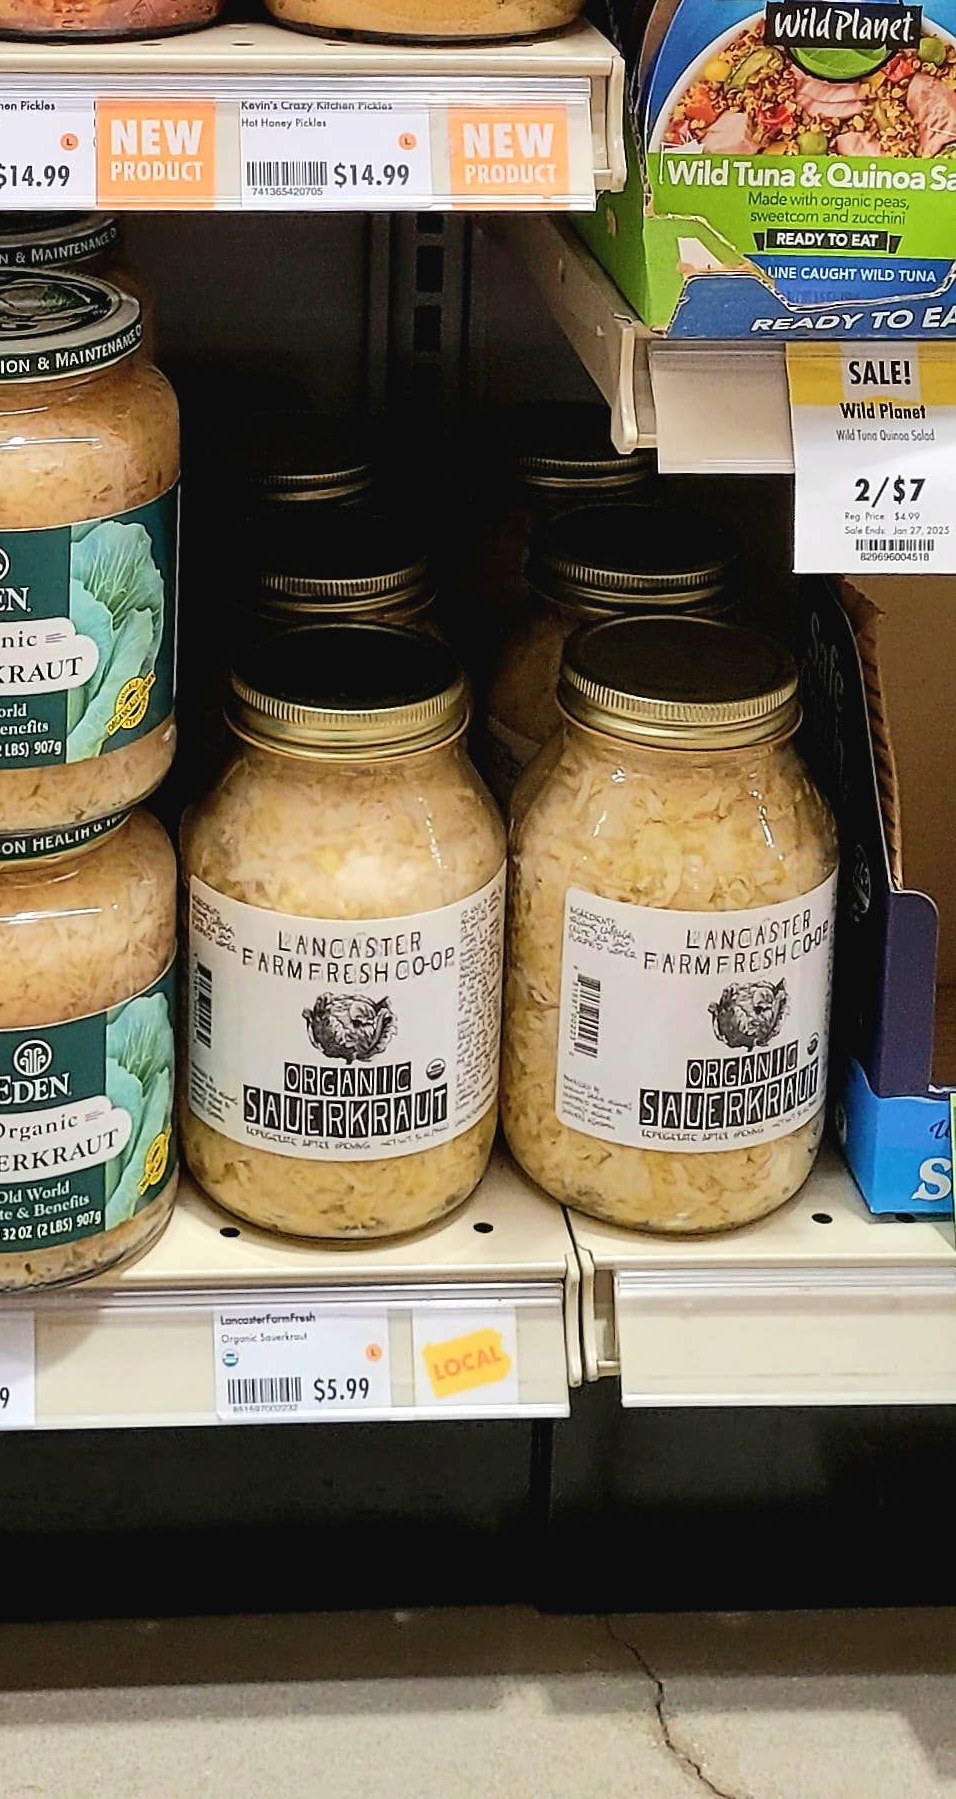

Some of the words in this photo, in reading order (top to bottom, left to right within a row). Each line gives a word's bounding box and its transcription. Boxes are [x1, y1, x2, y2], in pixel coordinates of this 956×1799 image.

[241, 118, 258, 127] Hot
[261, 118, 292, 129] Honey
[296, 118, 326, 127] Pickles
[111, 120, 204, 155] NEW
[463, 123, 554, 159] NEW
[111, 161, 203, 181] PRODUCT
[334, 162, 409, 188] $14.99
[465, 164, 556, 184] PRODUCT
[667, 159, 728, 187] Wild
[733, 161, 794, 187] Tuna
[801, 162, 822, 187] &
[827, 164, 925, 189] Quinoa
[16, 252, 25, 263] &
[32, 235, 109, 262] MAINTENANCE
[776, 234, 825, 245] READY
[827, 235, 848, 246] TO
[852, 235, 878, 247] EAT
[768, 266, 796, 278] LINE
[801, 268, 857, 280] CAUGHT
[861, 269, 894, 281] WILD
[898, 270, 936, 282] TUNA
[38, 358, 49, 369] &
[55, 328, 135, 369] MAINTENANCE
[849, 361, 911, 385] SALE!
[840, 403, 874, 419] Wild
[881, 403, 926, 419] Planet
[278, 931, 421, 959] LANCASTER
[687, 1042, 798, 1087] ORGANIC
[244, 1084, 447, 1138] SAUERKRAUT
[27, 1181, 70, 1200] World
[16, 1207, 29, 1219] &
[33, 1195, 90, 1217] Benefits
[433, 1346, 502, 1381] LOCAL
[314, 1376, 369, 1402] $5.99
